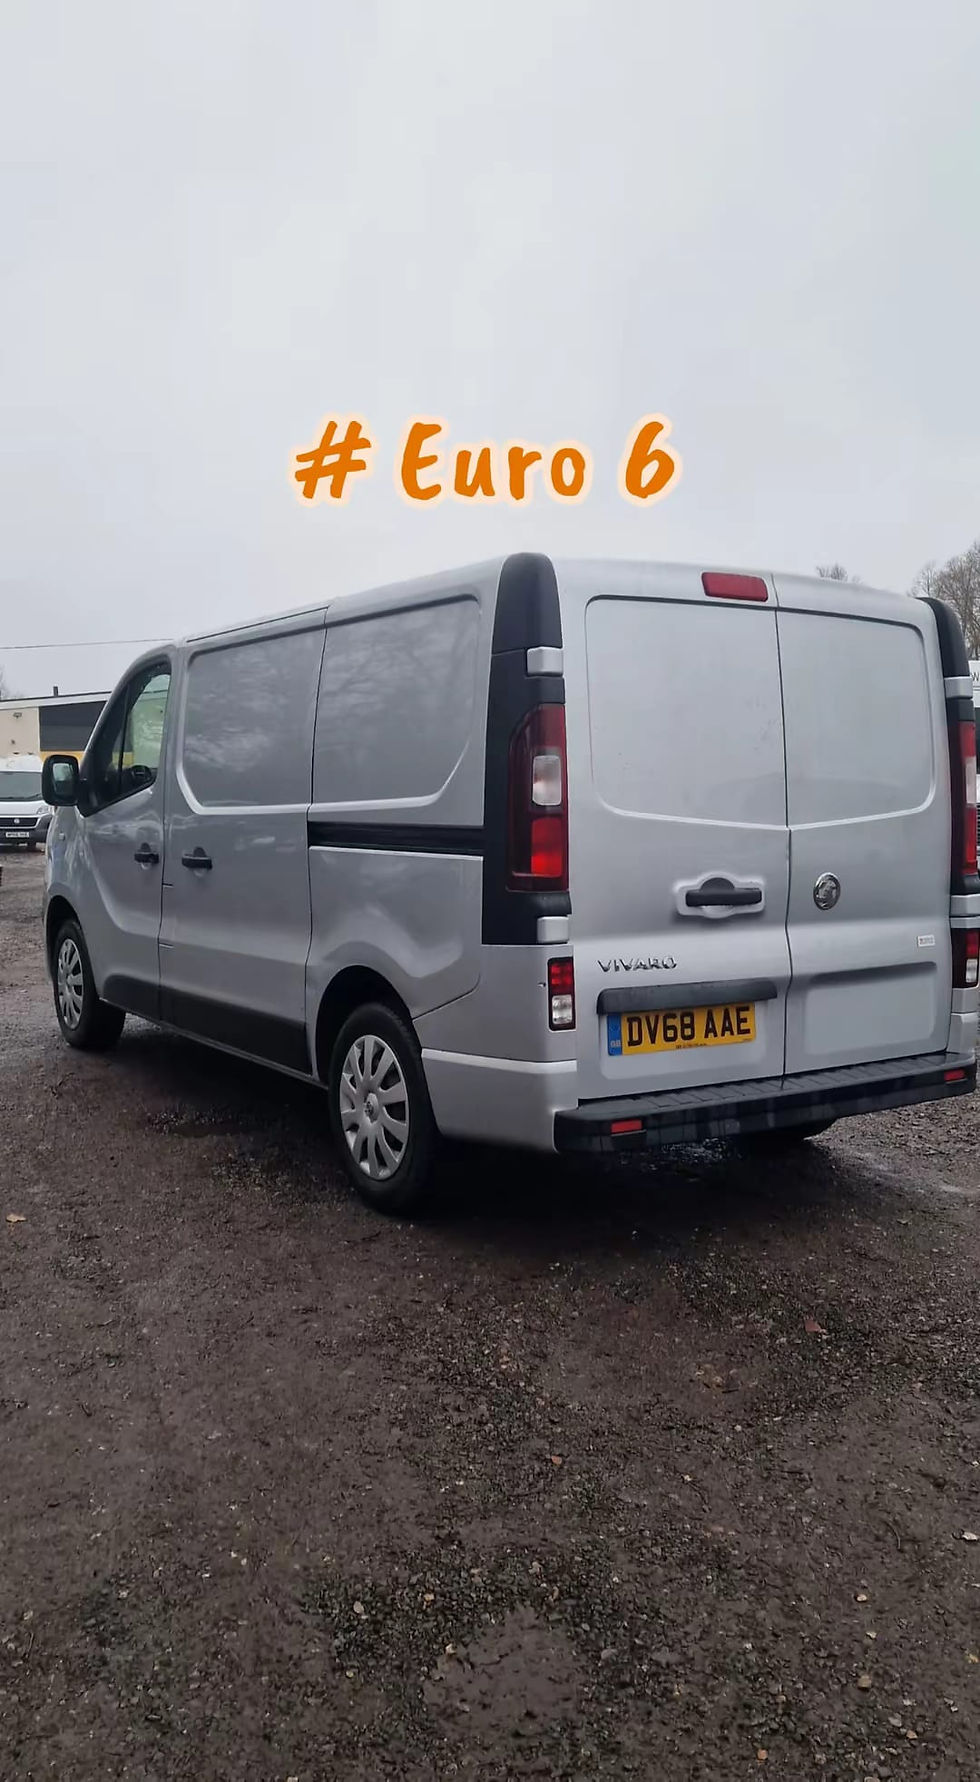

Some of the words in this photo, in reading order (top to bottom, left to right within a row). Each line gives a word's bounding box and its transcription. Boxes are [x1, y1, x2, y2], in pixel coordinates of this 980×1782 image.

[597, 957, 677, 973] VIVARO
[626, 1011, 695, 1046] DV68
[703, 1006, 751, 1039] AAE
